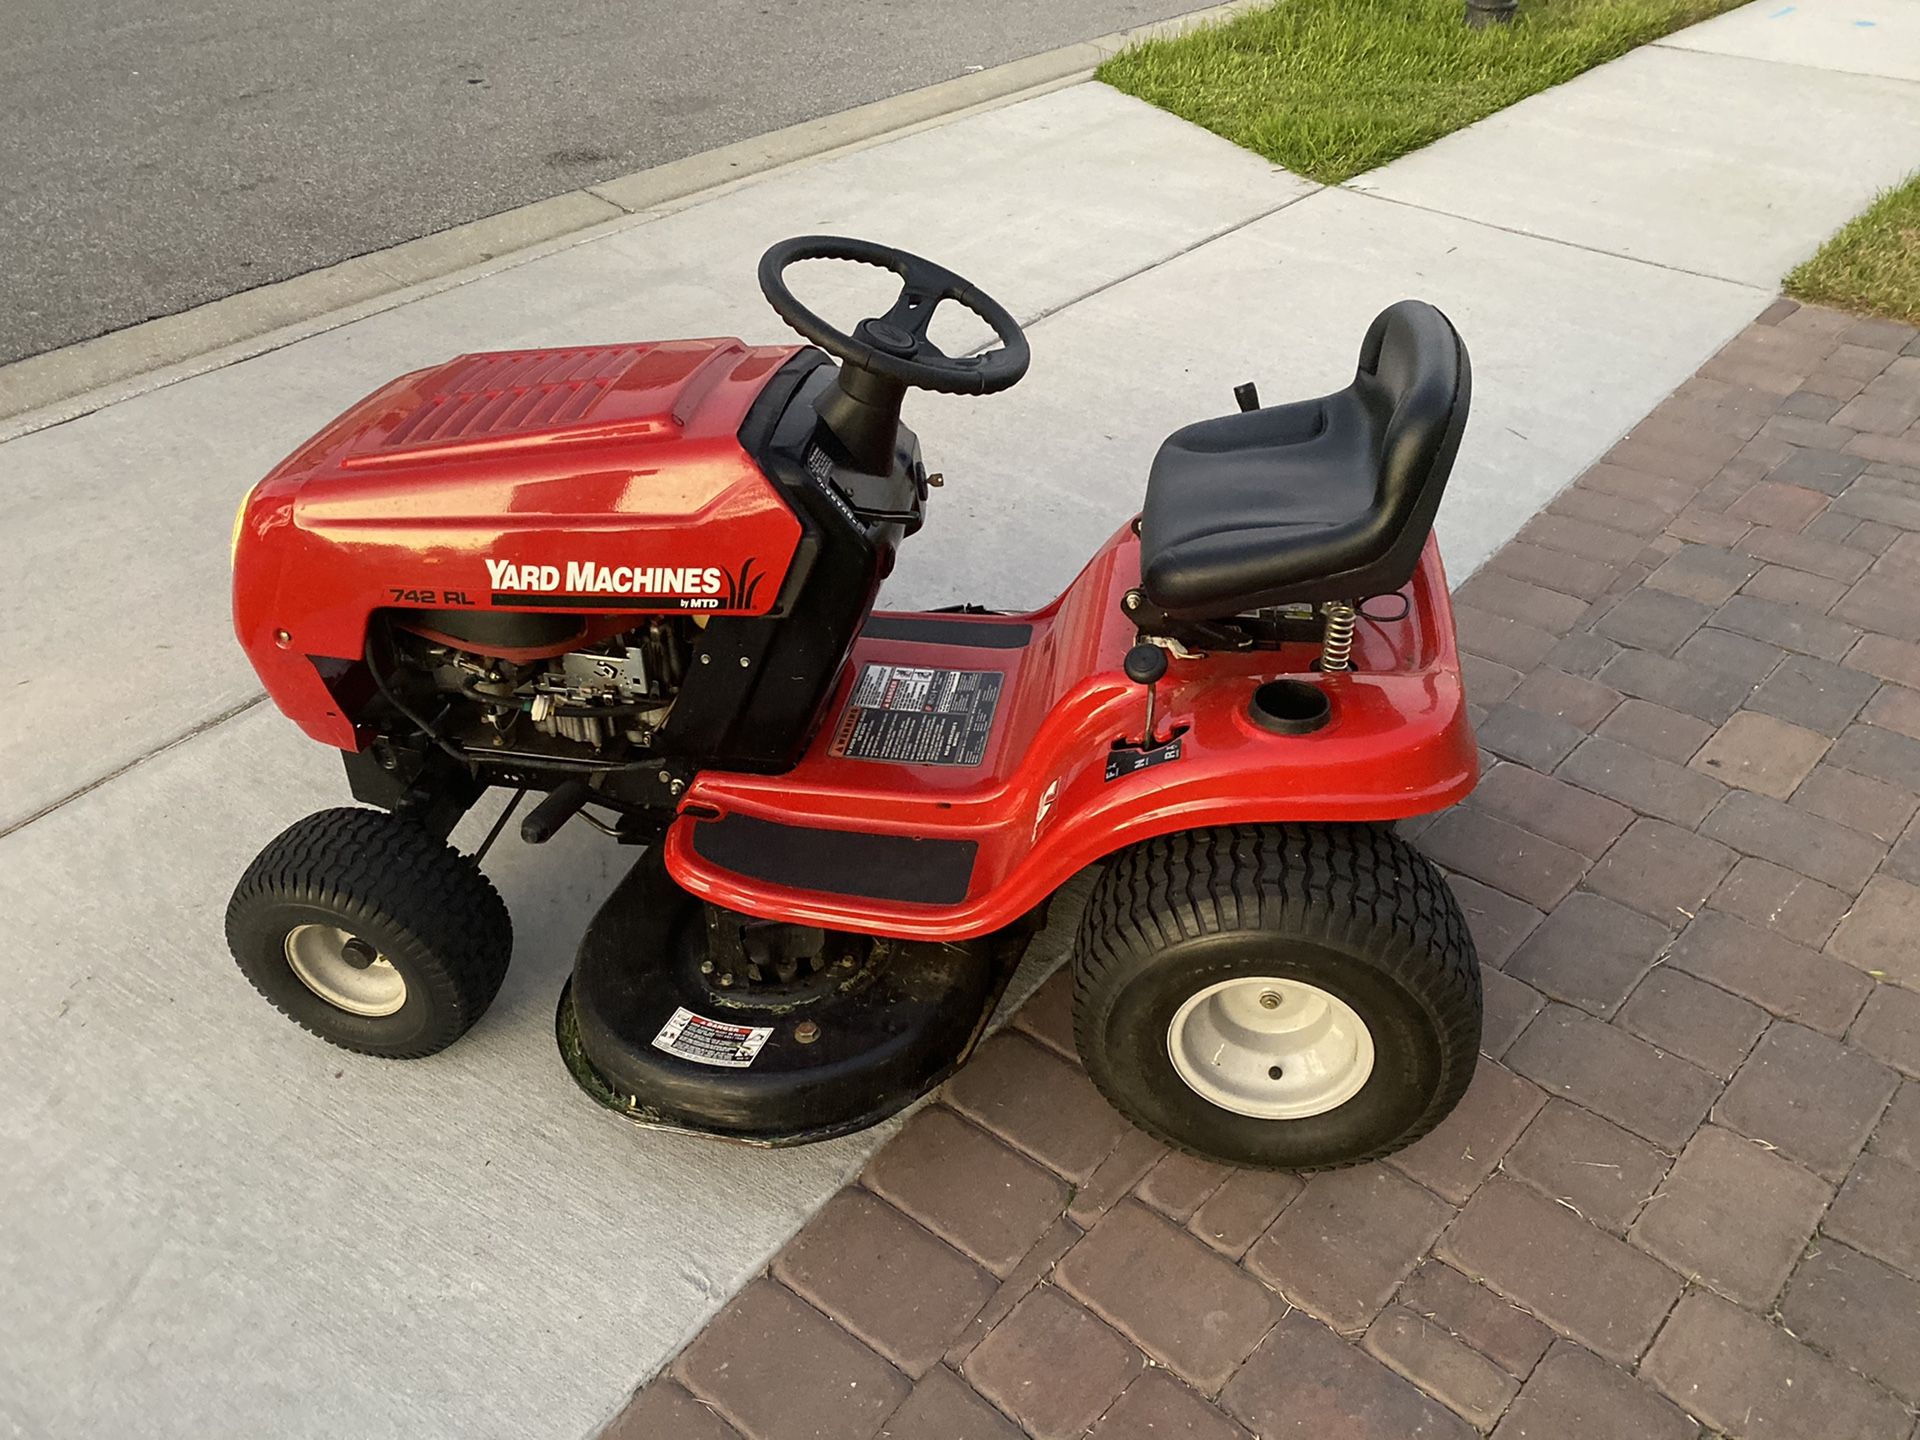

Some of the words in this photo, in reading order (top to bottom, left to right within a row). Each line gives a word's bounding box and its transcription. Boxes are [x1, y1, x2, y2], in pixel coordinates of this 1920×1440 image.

[485, 559, 559, 591] YARD
[566, 561, 721, 594] MACHINES
[389, 588, 436, 603] 742
[443, 591, 475, 605] RL
[680, 598, 689, 608] by
[690, 599, 719, 608] MTD
[706, 1023, 739, 1032] DANGER
